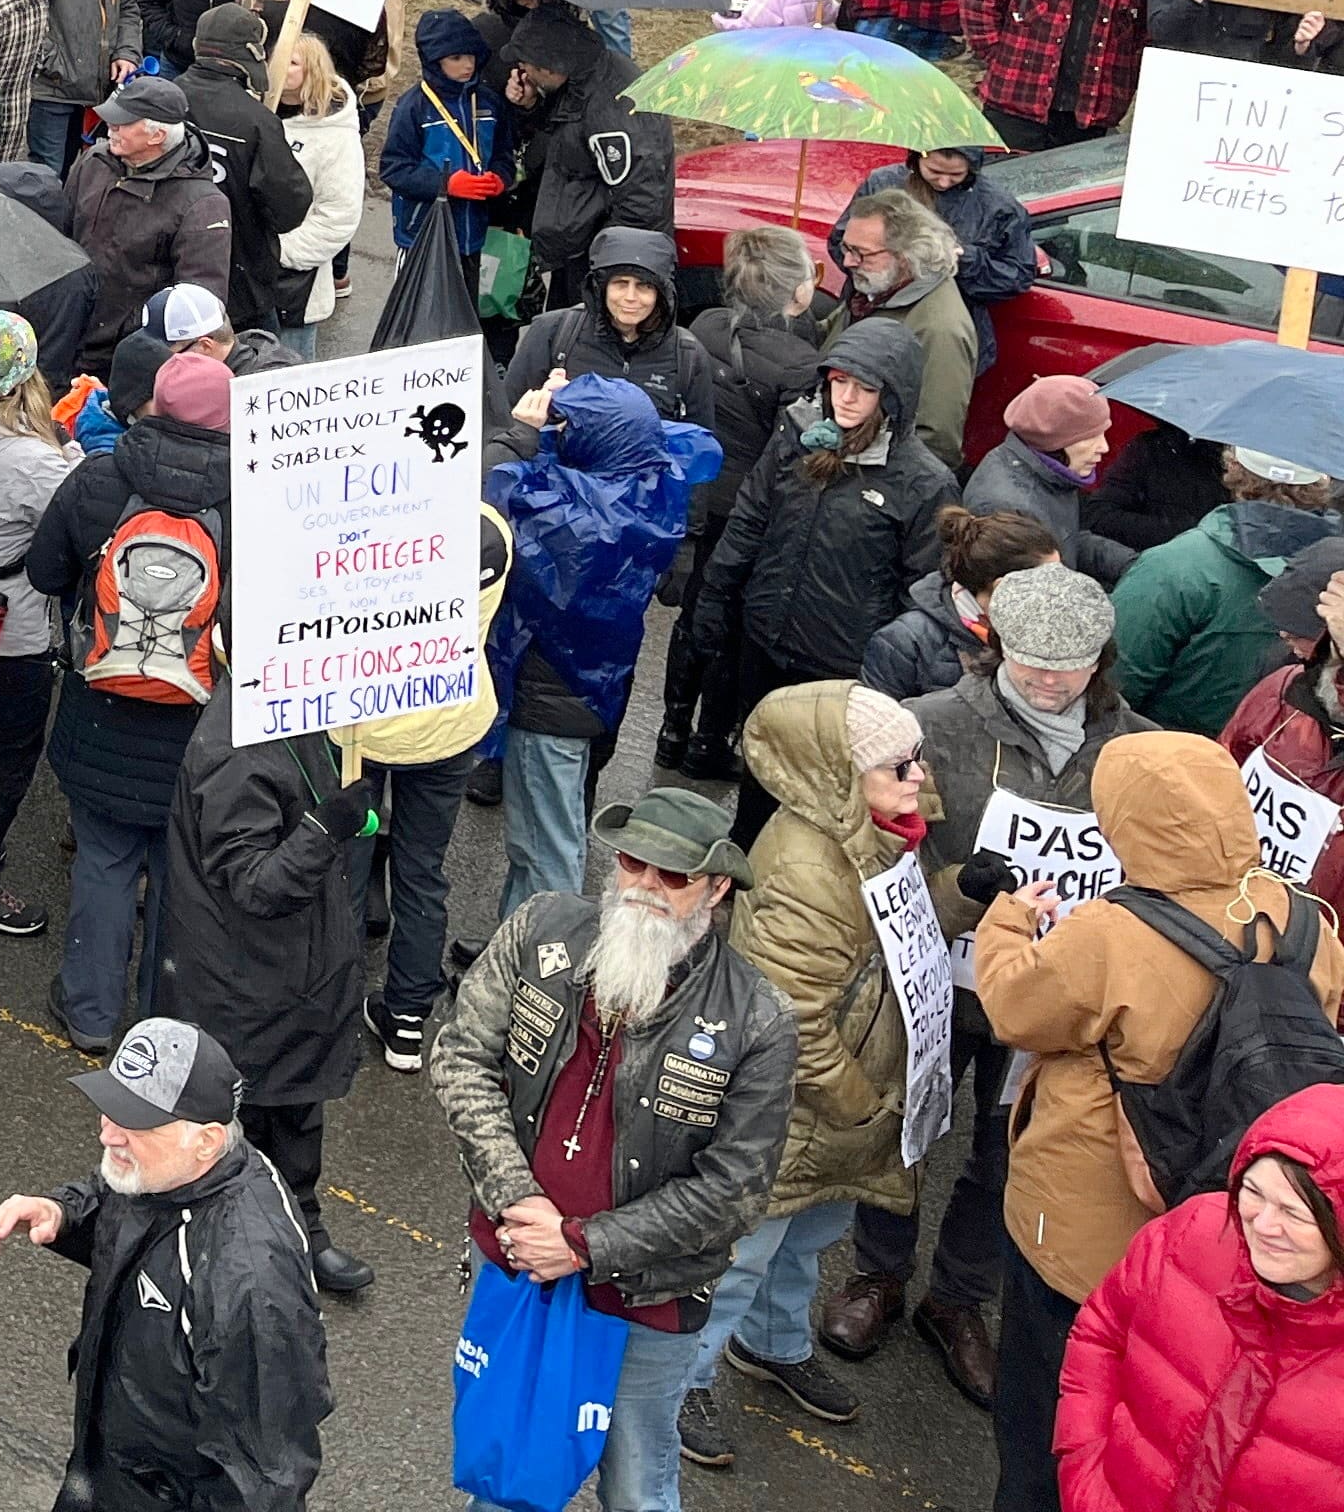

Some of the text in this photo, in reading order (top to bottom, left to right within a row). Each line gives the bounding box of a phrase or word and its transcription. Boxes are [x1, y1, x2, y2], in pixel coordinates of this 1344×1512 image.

[1215, 137, 1289, 169] NON
[404, 367, 472, 391] HORNE
[271, 444, 366, 470] STABLEX
[285, 457, 411, 511] UN BON
[303, 499, 432, 530] GOUVERNEMENT
[315, 534, 445, 579] PROTÉGER
[298, 586, 327, 600] SES
[319, 590, 414, 614] ET NON LES
[407, 635, 462, 668] 2026
[263, 699, 292, 734] JE
[303, 691, 338, 730] ME
[1007, 767, 1307, 862] PAS PAS
